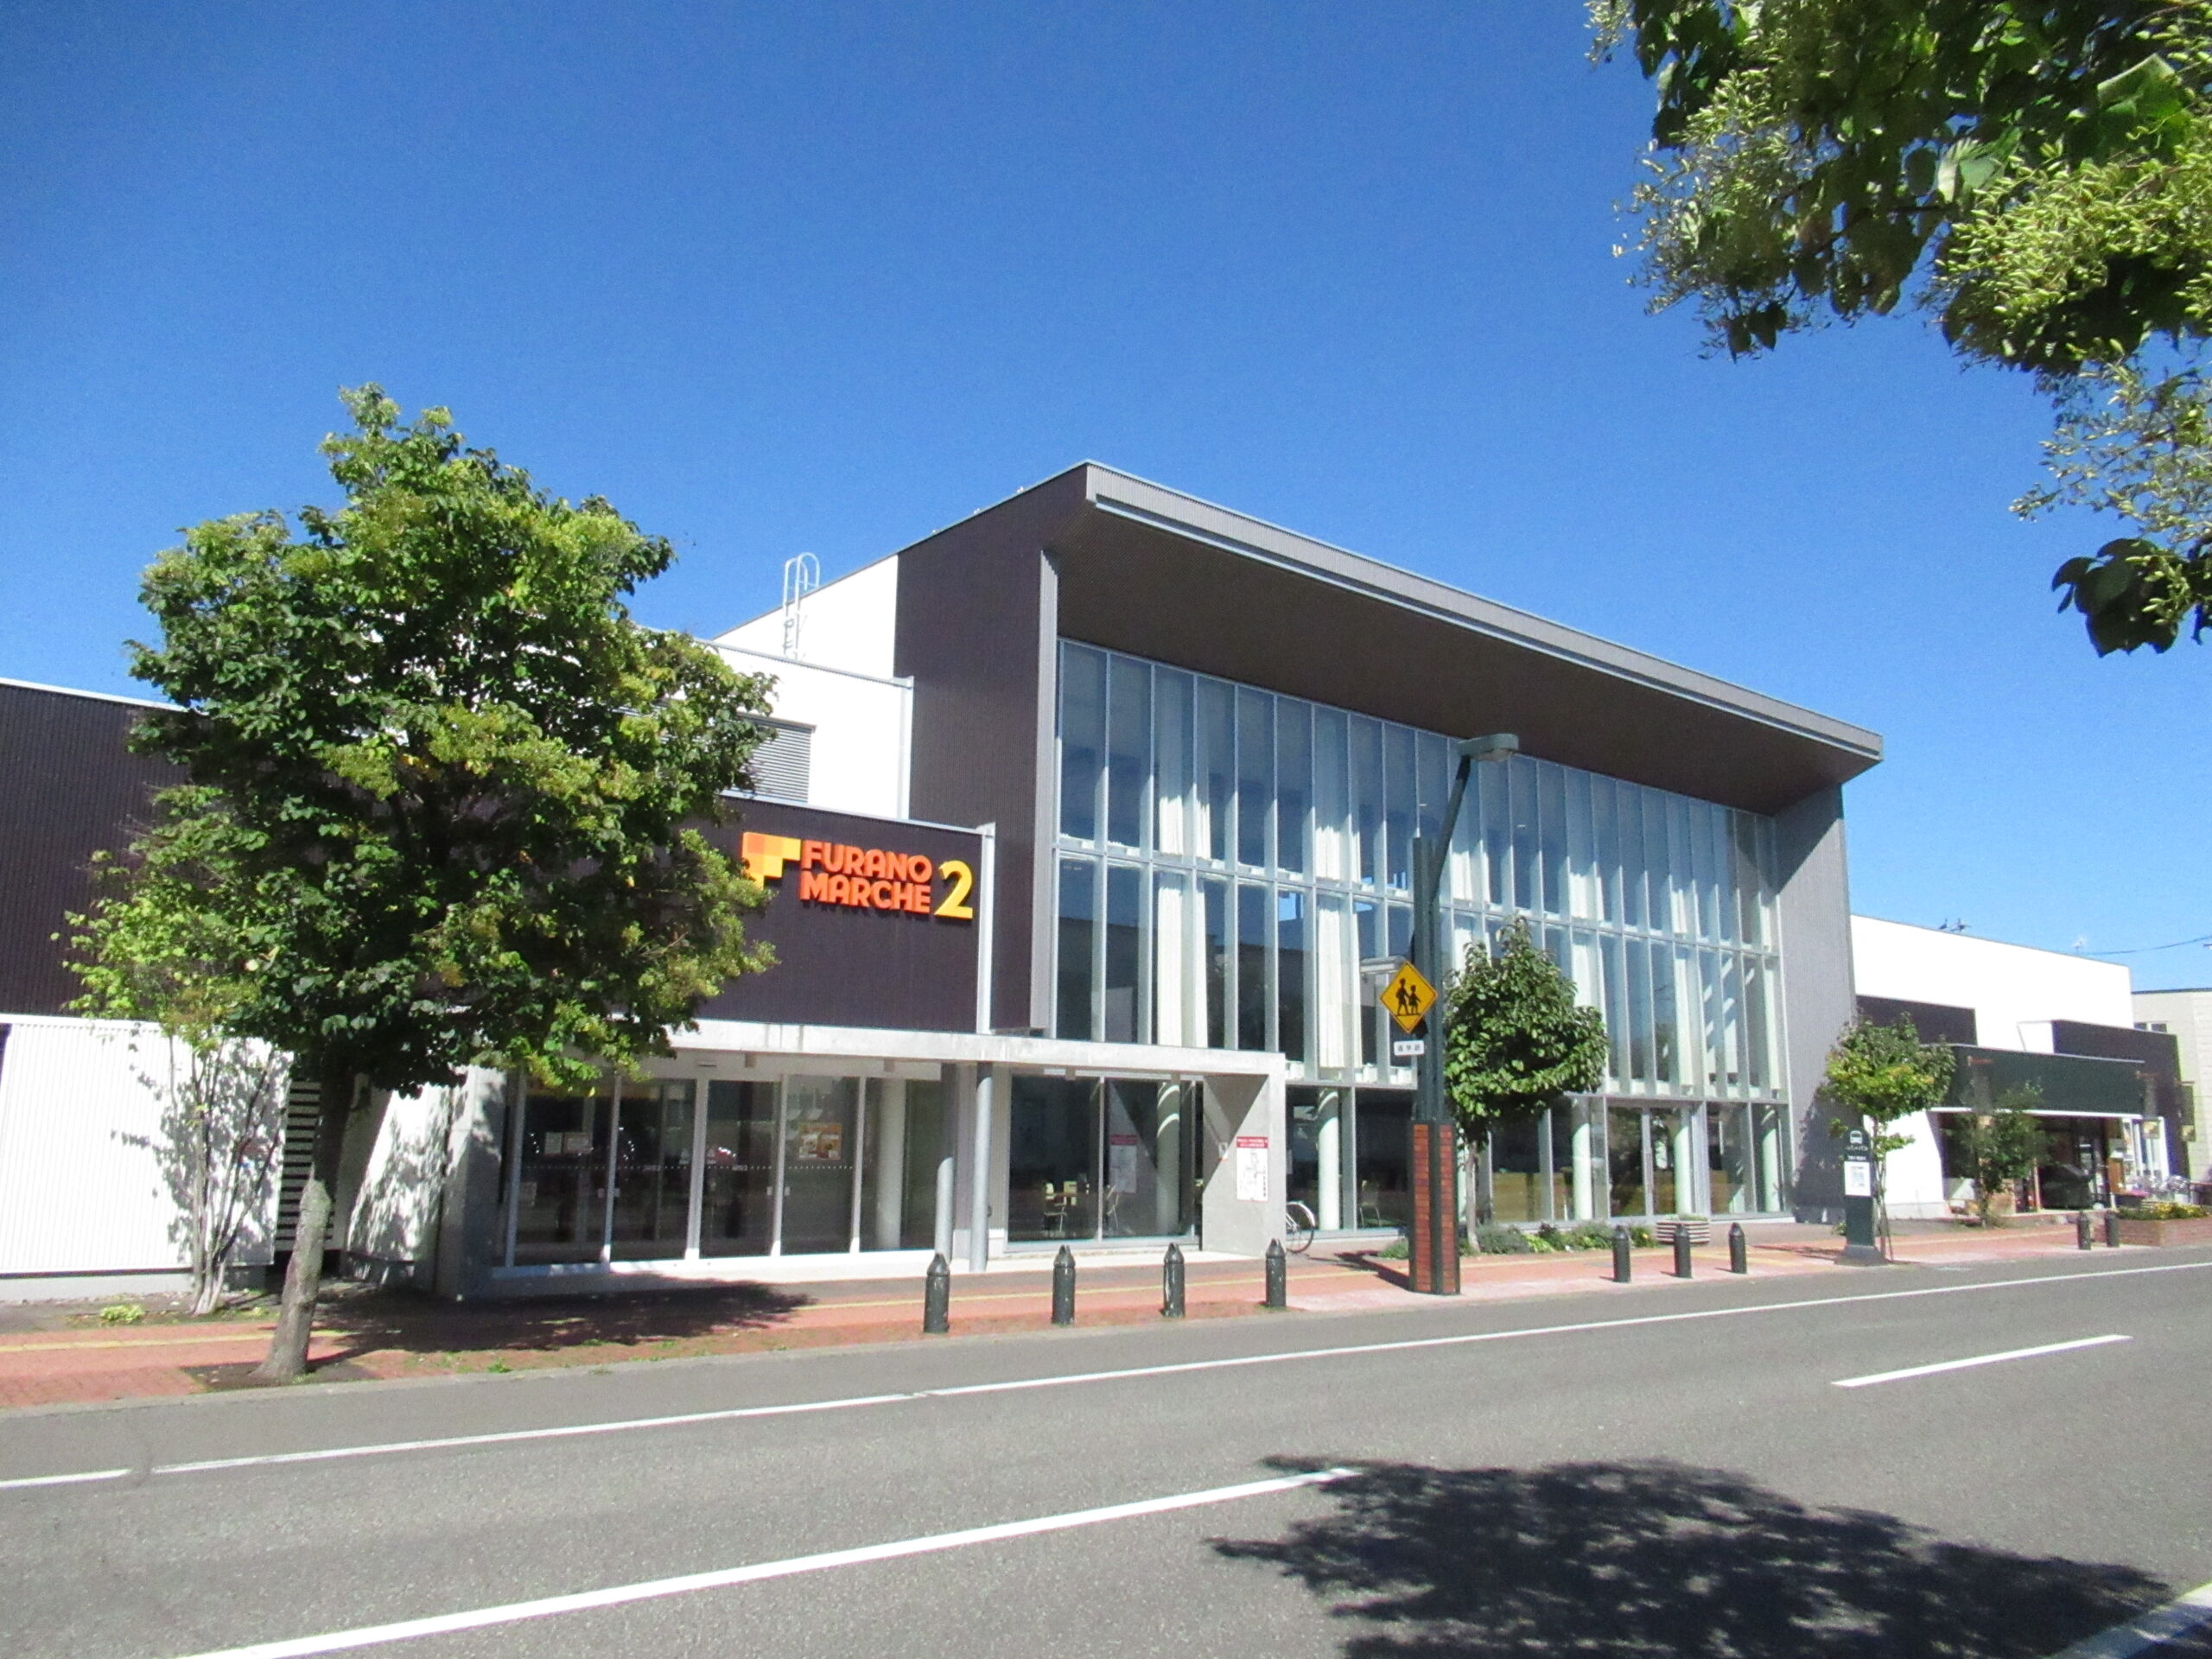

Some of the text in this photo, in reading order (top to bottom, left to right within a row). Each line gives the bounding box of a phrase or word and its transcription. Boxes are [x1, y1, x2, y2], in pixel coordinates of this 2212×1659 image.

[801, 839, 932, 883] FURANO
[800, 861, 973, 918] MARCHE 2
